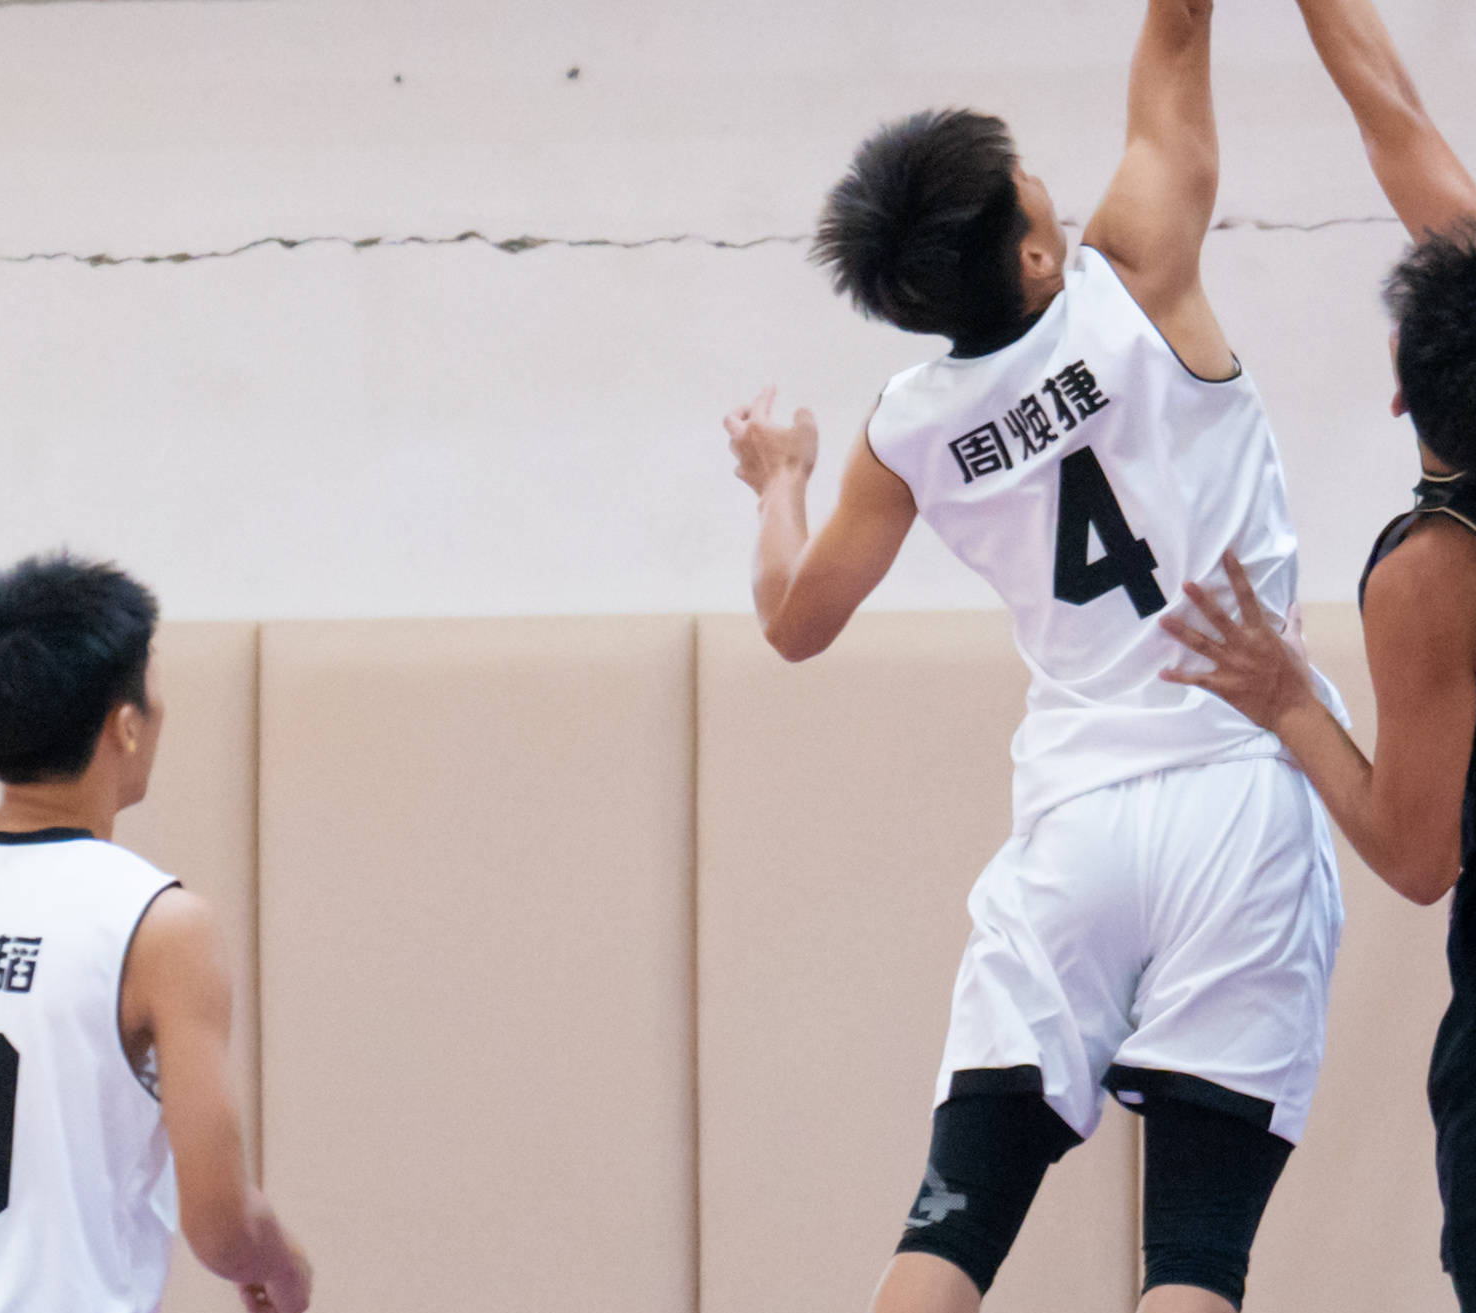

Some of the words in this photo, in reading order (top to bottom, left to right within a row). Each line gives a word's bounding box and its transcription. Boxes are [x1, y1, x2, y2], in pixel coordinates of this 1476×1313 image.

[948, 359, 1110, 484] 周焕捷
[1053, 445, 1167, 620] 4
